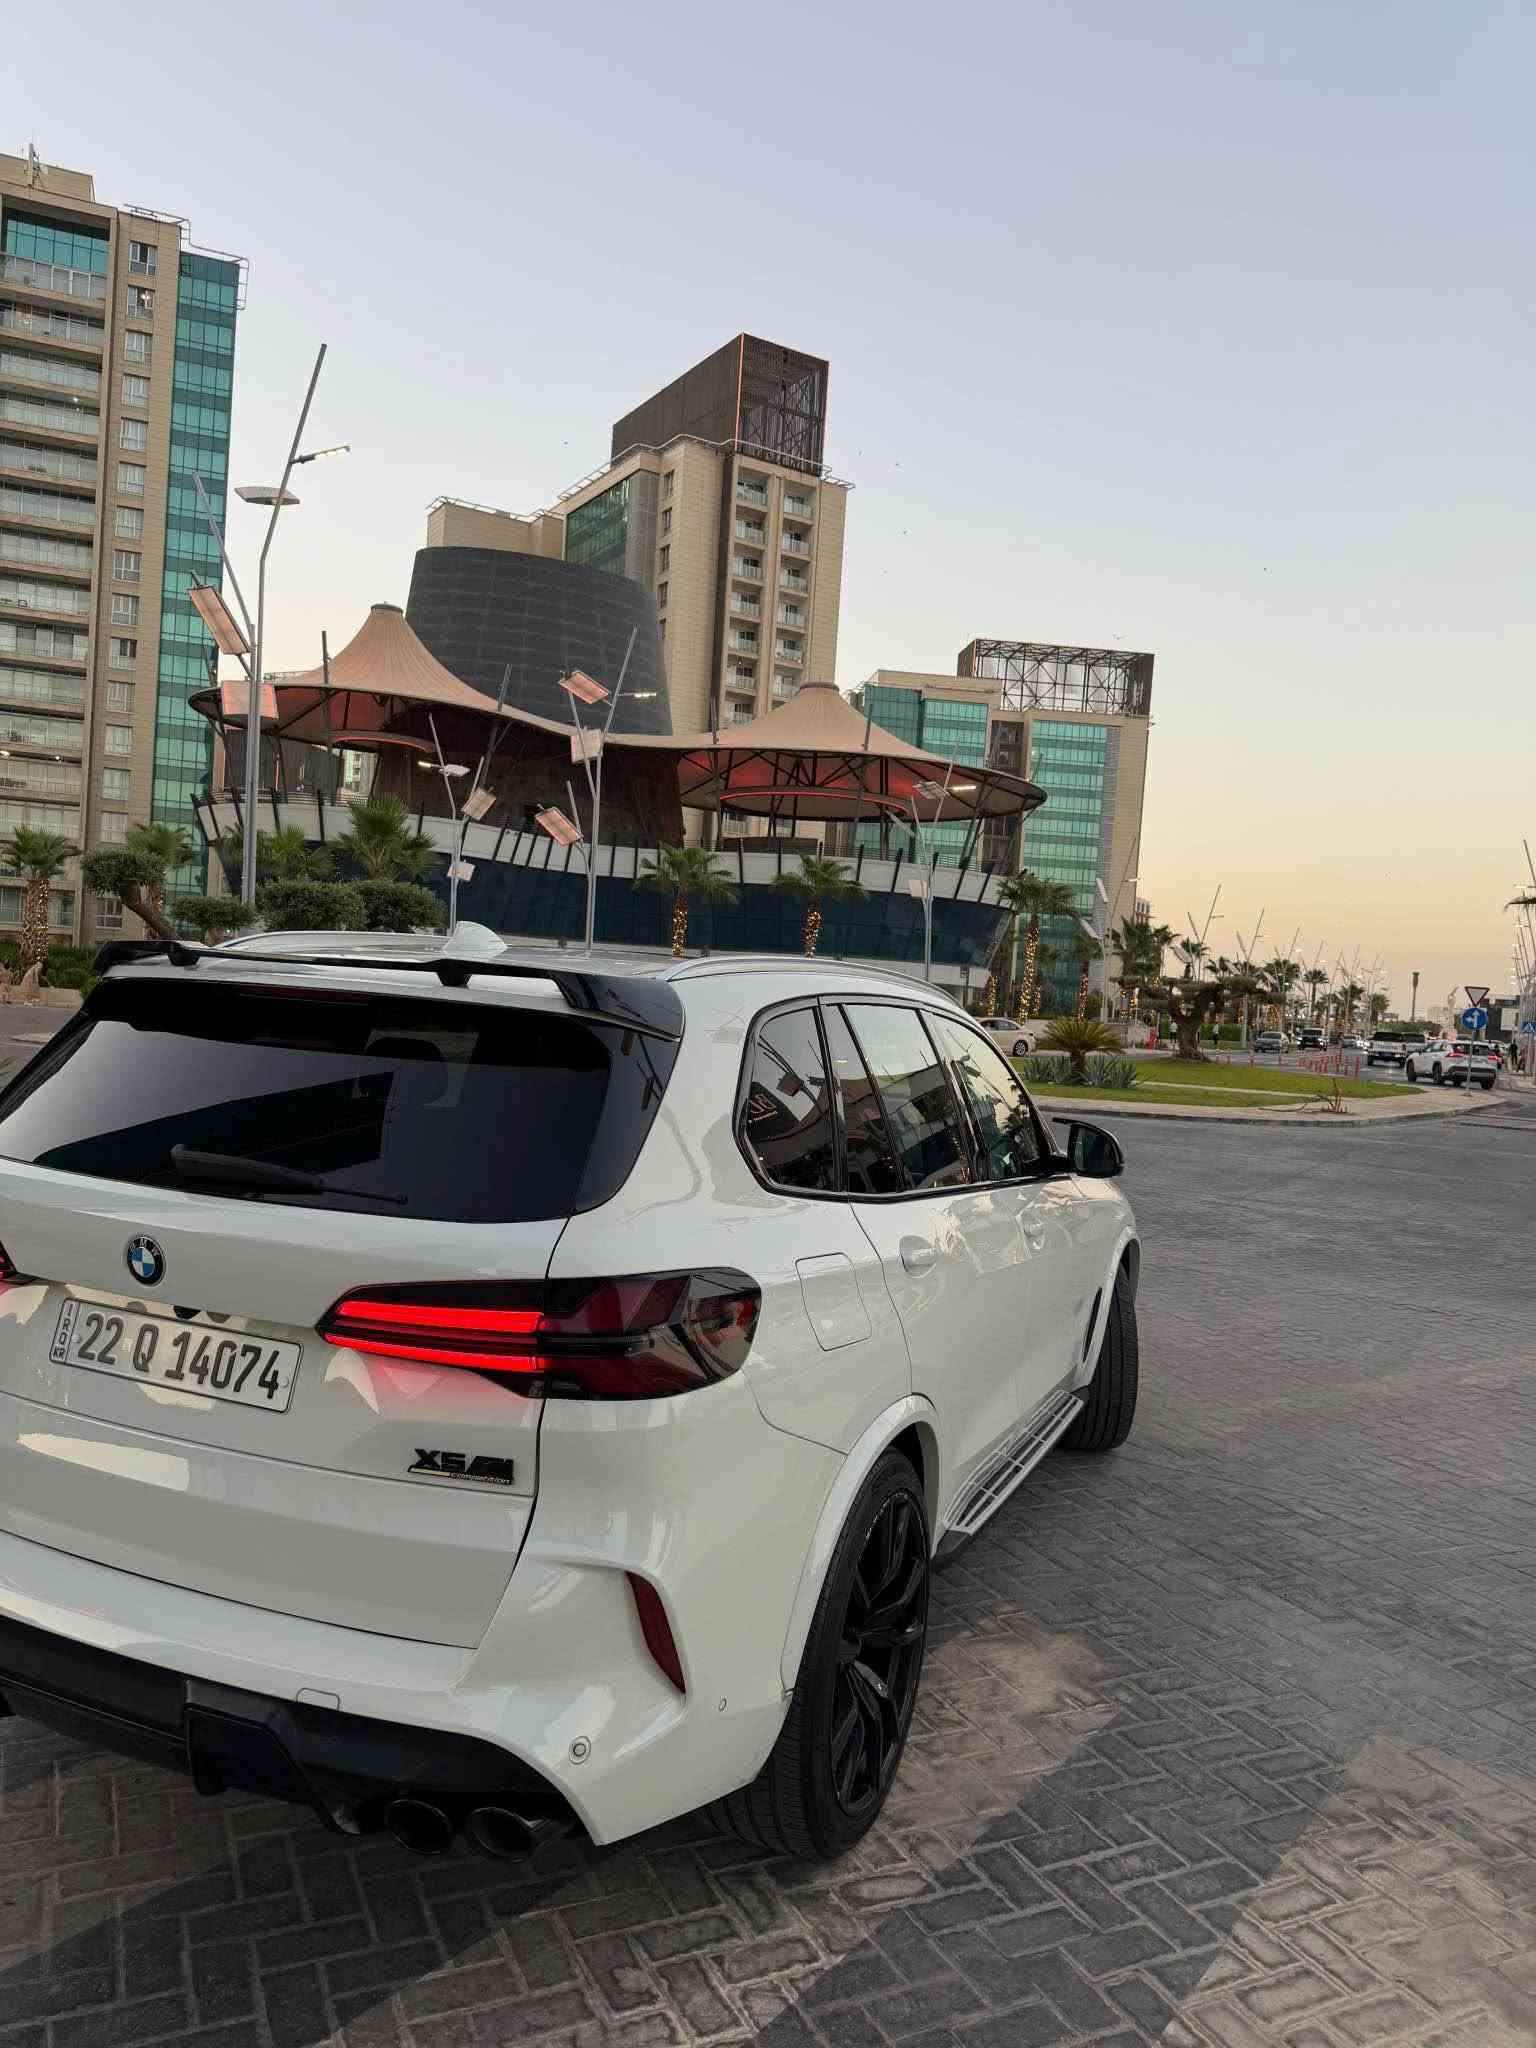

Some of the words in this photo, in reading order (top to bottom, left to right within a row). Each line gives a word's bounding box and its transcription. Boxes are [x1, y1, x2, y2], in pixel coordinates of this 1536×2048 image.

[78, 1312, 124, 1366] 22
[133, 1323, 159, 1373] Q
[164, 1331, 280, 1399] 14074
